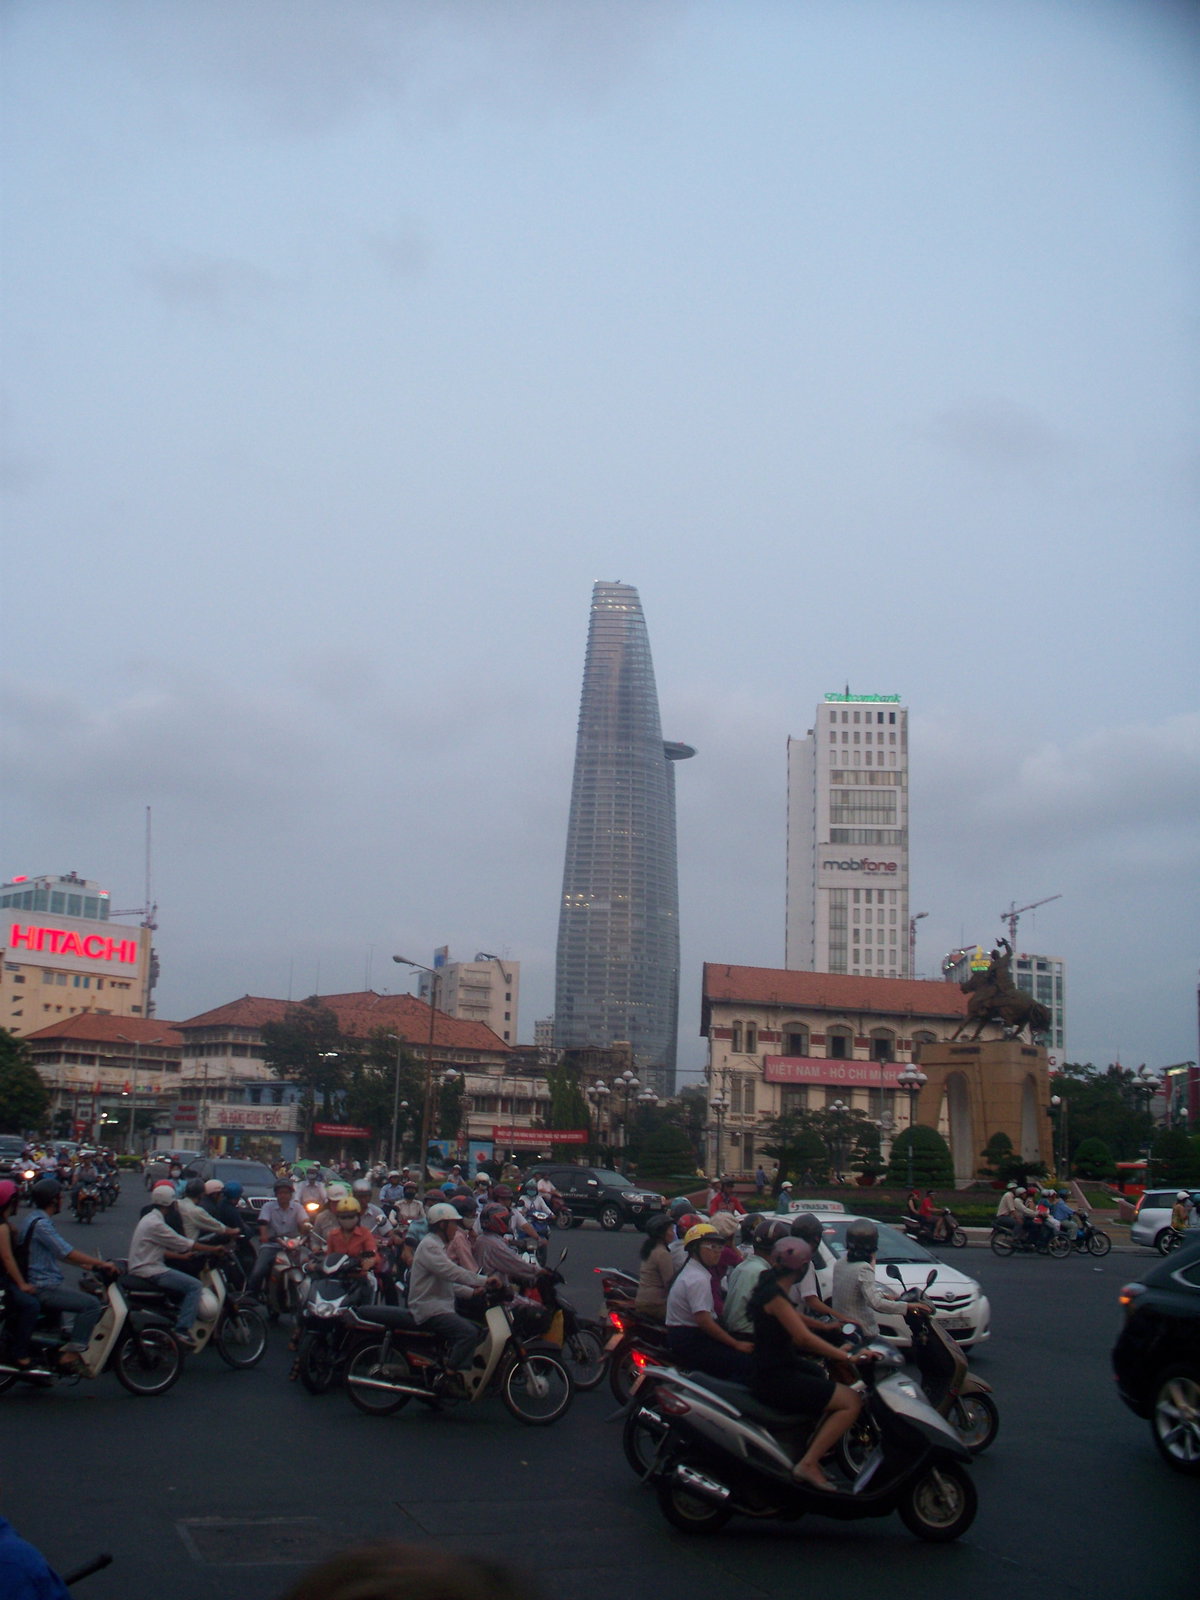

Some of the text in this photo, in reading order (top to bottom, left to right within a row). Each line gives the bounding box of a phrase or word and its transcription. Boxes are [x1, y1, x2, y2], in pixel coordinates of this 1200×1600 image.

[823, 857, 898, 871] mobifone
[10, 923, 138, 965] HITACHI
[767, 1060, 793, 1076] VIỆT
[796, 1064, 821, 1077] NAM
[830, 1063, 847, 1079] HỒ
[869, 1069, 896, 1082] MINH
